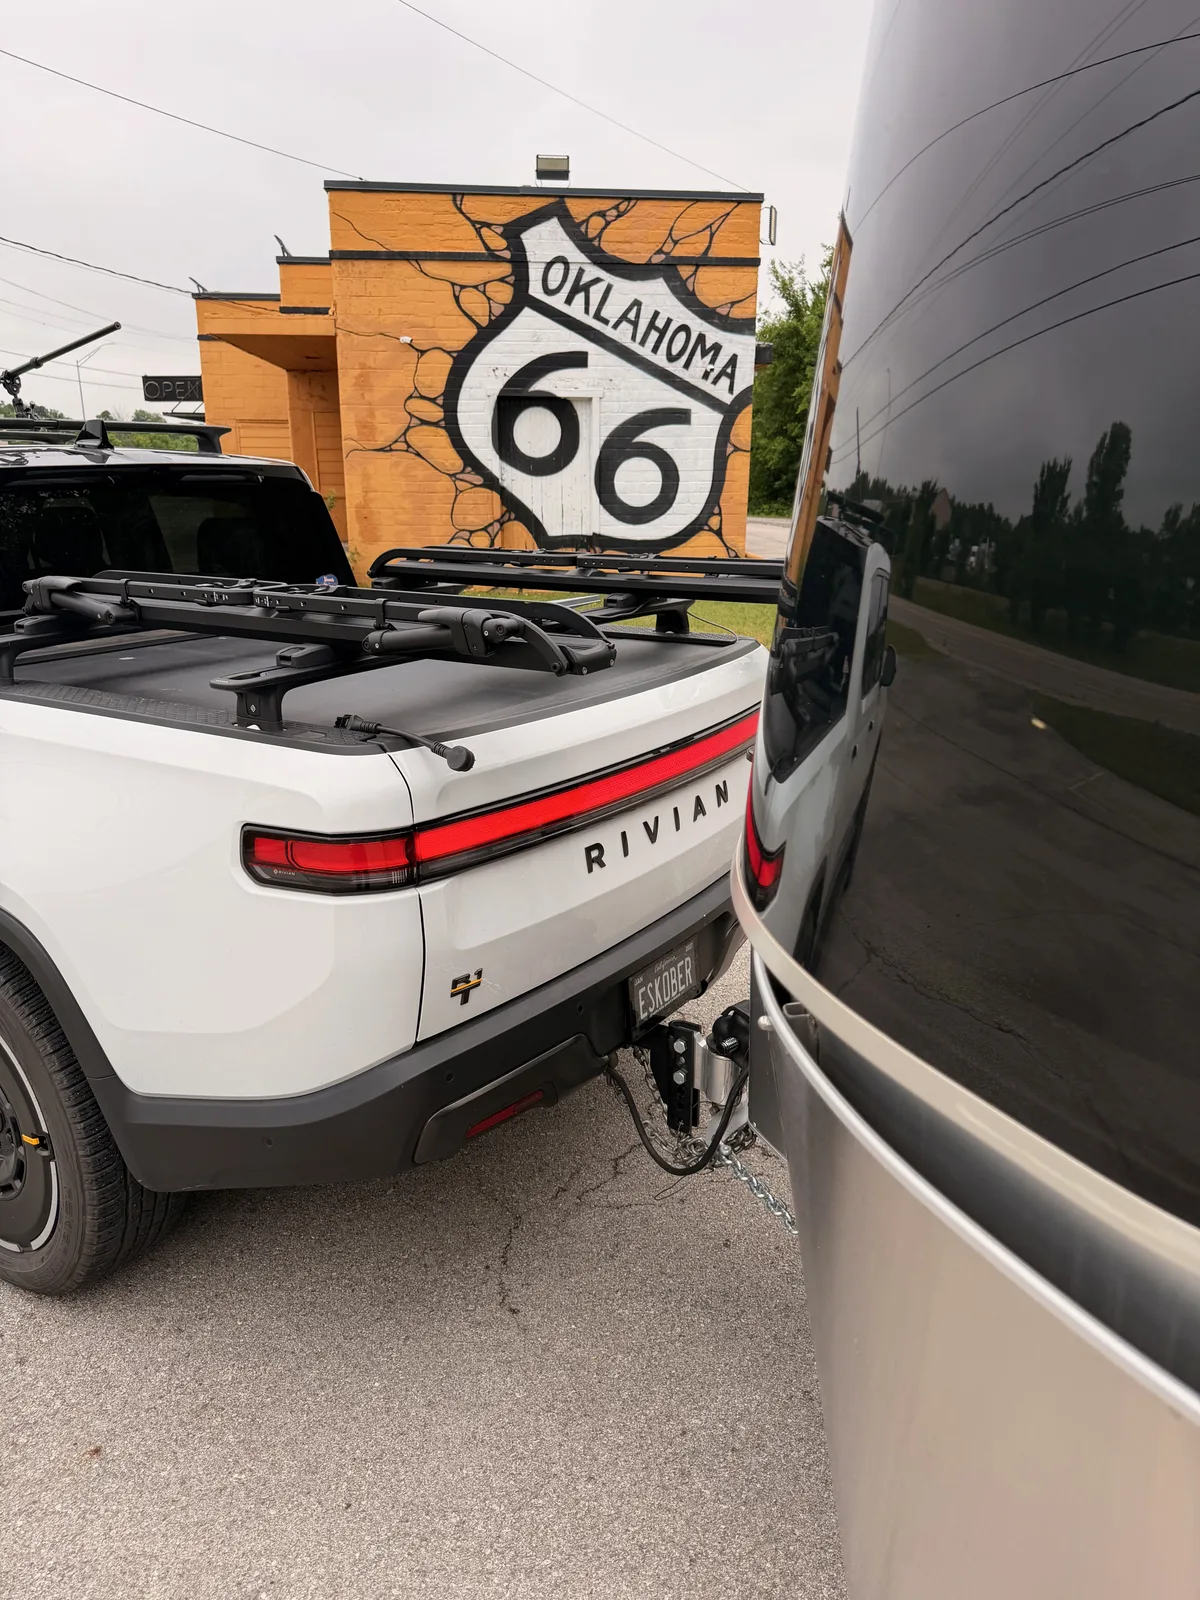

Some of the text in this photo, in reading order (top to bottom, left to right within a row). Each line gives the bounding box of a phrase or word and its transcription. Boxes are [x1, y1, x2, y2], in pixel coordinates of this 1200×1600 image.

[541, 255, 739, 395] OKLAHOMA
[144, 380, 200, 399] OPEN
[491, 351, 692, 526] 66
[584, 780, 729, 874] RIVIAN
[638, 956, 693, 1020] ESKOBER
